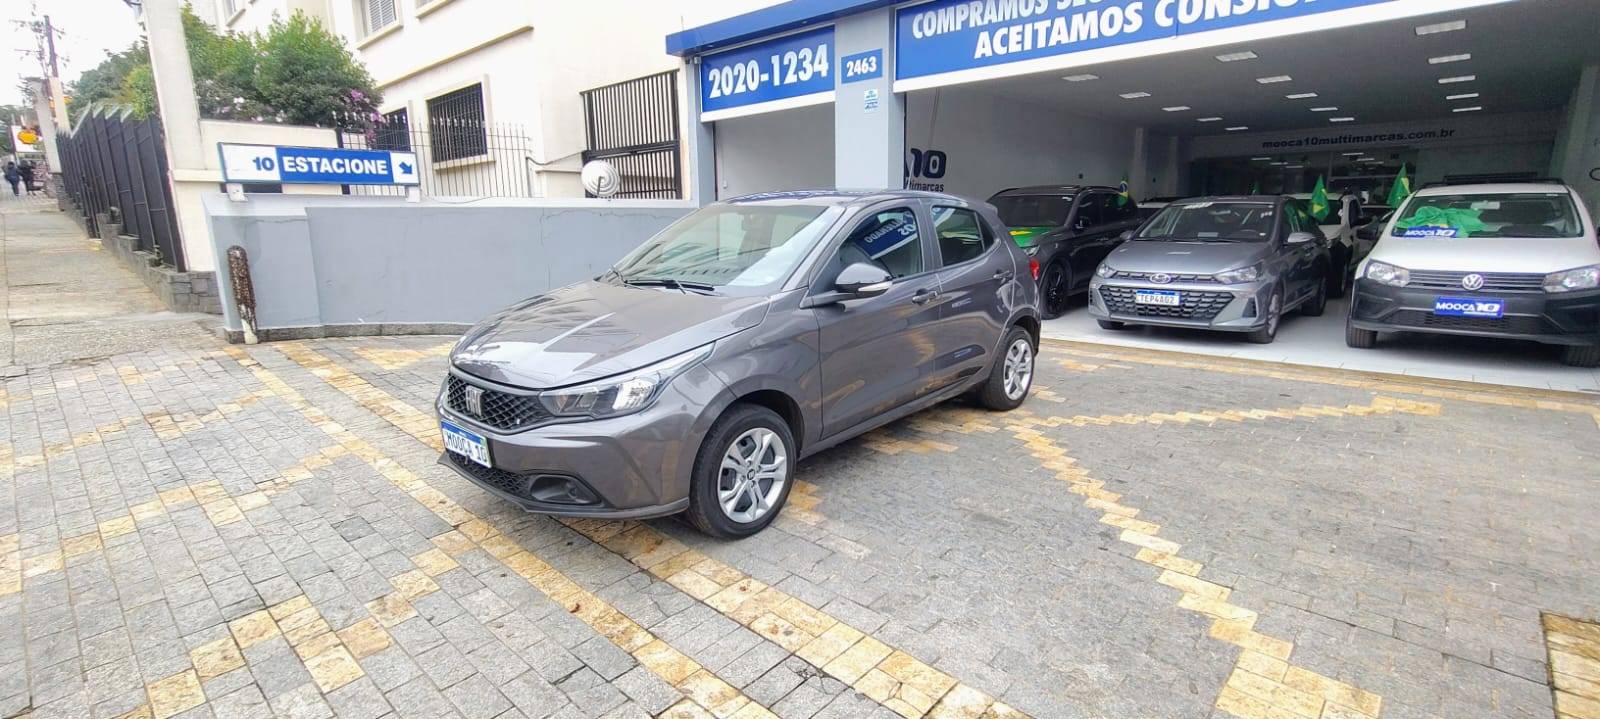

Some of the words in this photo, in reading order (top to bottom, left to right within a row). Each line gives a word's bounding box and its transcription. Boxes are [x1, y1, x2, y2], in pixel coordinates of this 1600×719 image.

[912, 0, 1049, 39] COMPRAMOS
[974, 2, 1143, 59] ACEITAMOS
[708, 43, 829, 99] 2020-1234
[846, 55, 877, 78] 2463
[1261, 127, 1455, 149] mooca10multimarcas.com.br
[252, 156, 274, 171] 10
[282, 156, 388, 175] ESTACIONE
[1436, 302, 1475, 311] MOOCA
[1475, 302, 1500, 312] 10
